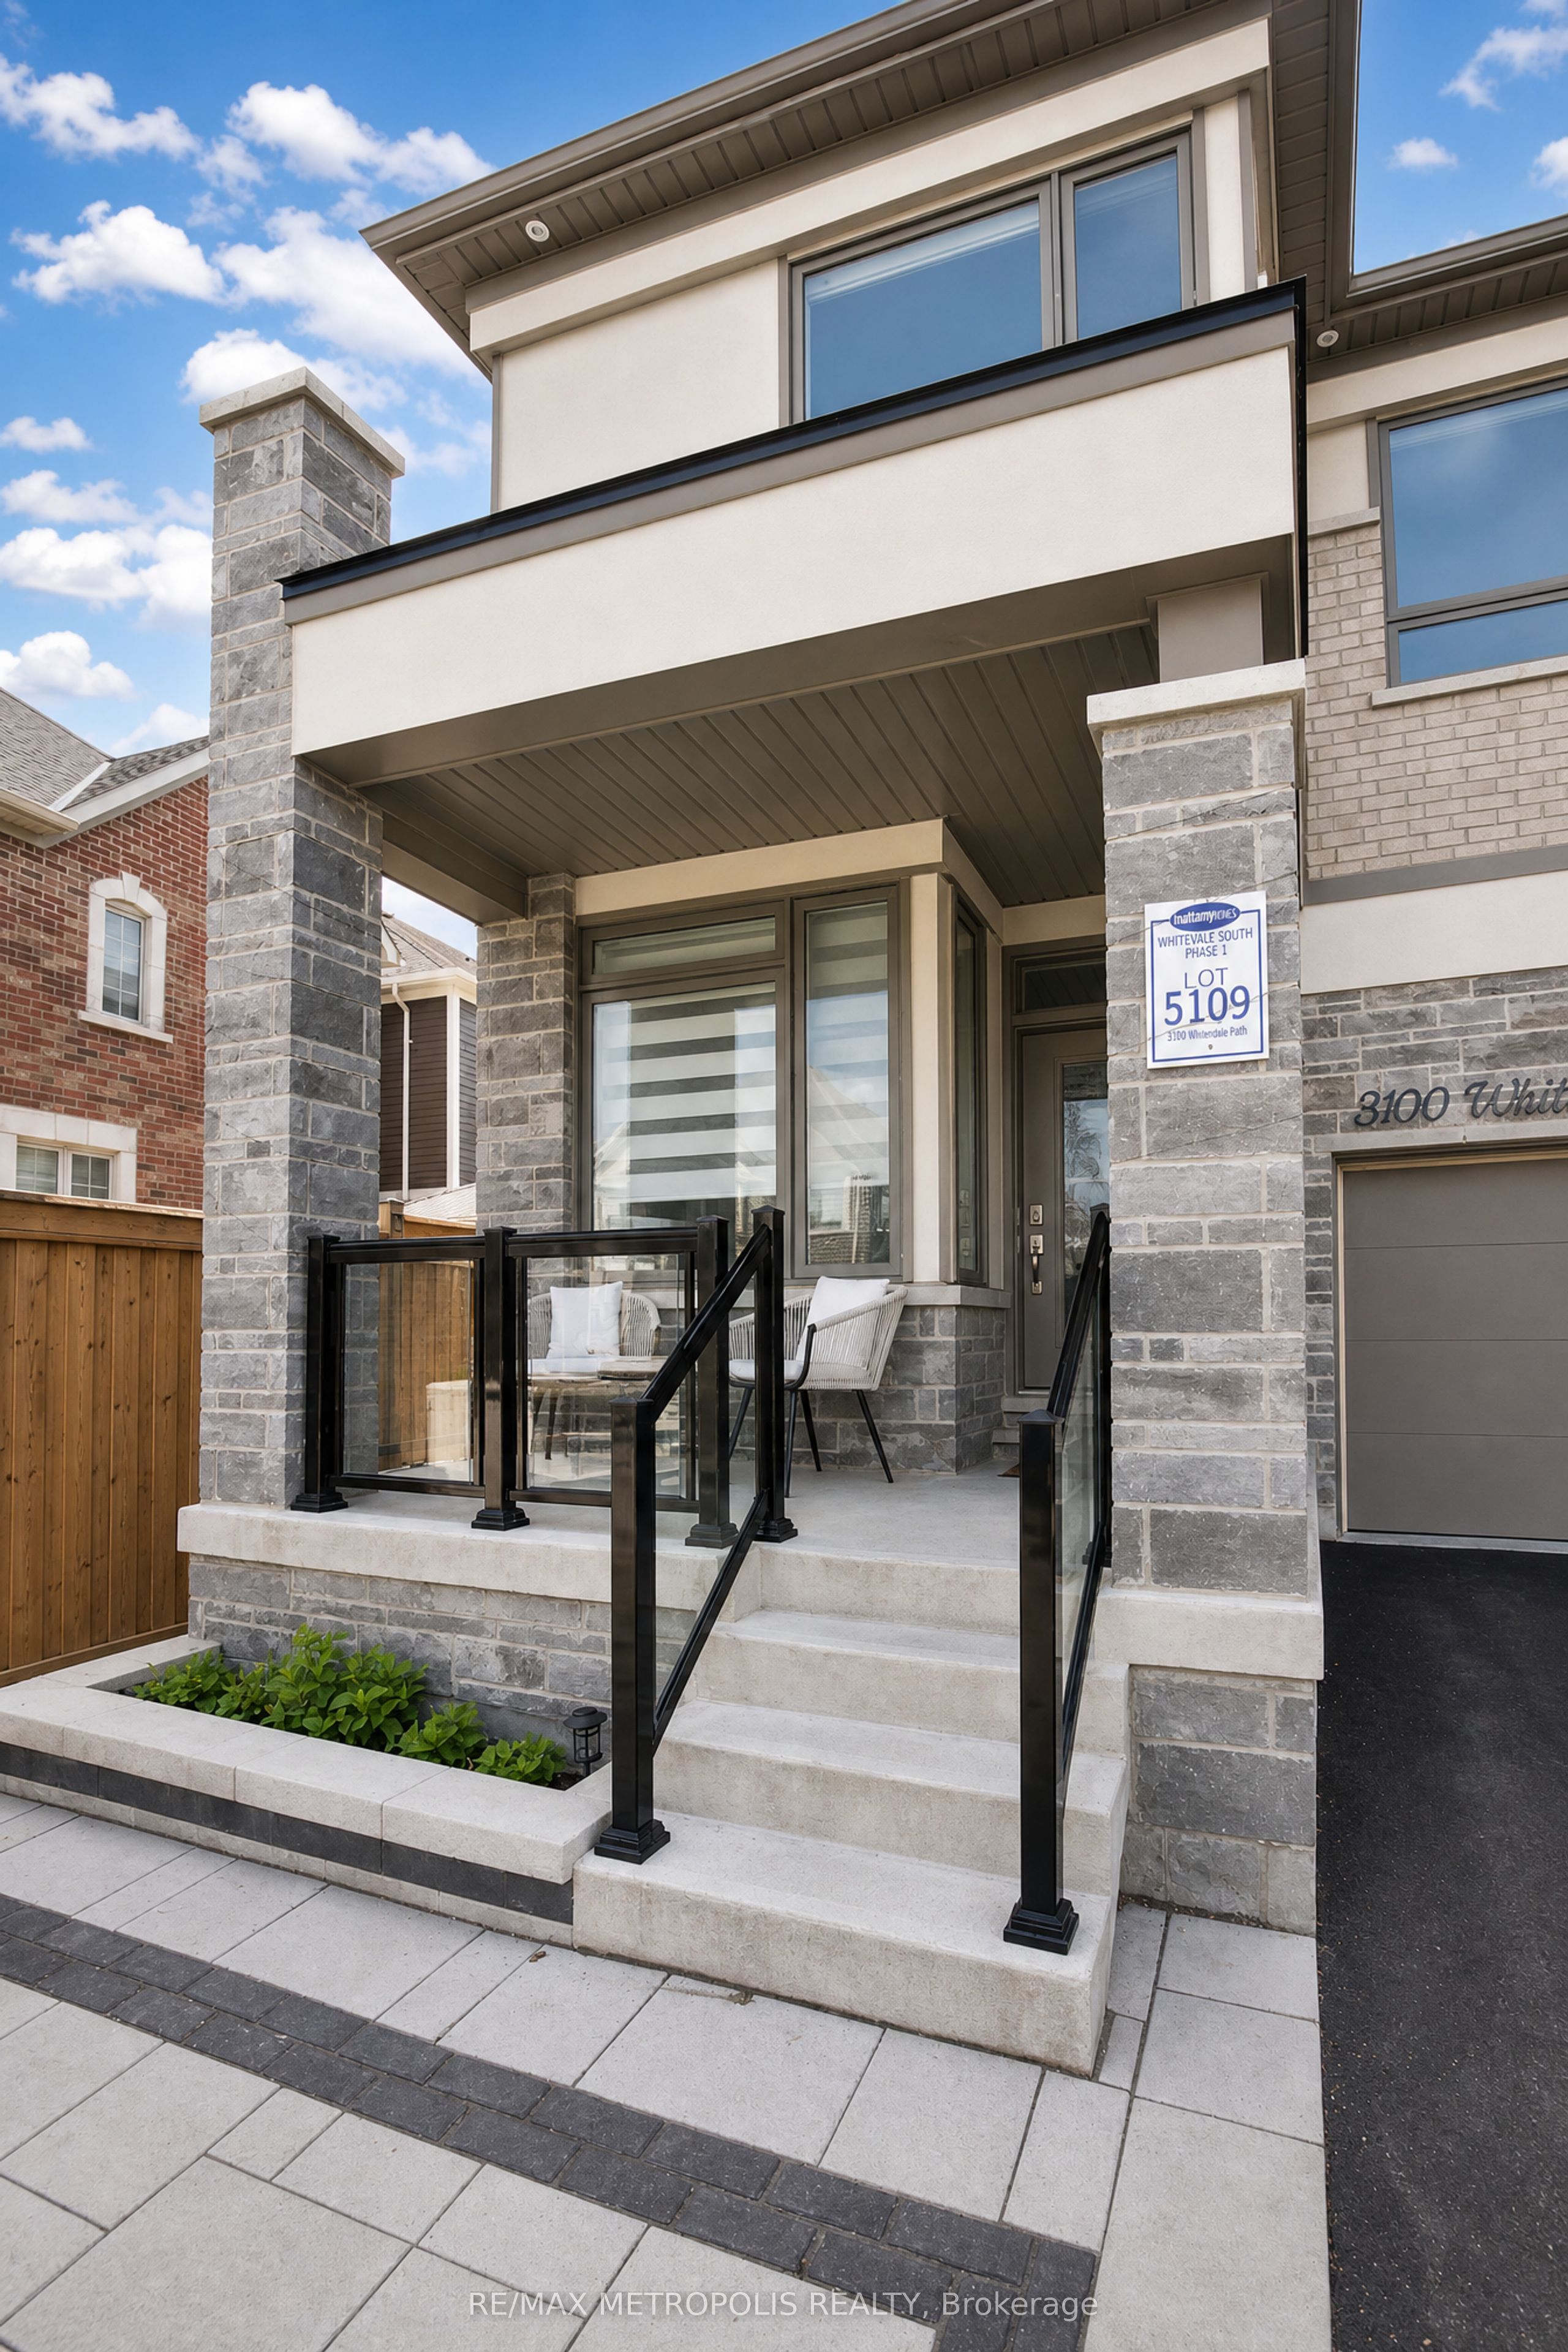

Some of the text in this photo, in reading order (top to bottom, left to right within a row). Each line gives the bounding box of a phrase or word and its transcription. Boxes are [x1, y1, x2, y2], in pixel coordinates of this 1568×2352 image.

[1158, 927, 1253, 948] WHITEVALE SOUTH
[1185, 944, 1227, 959] PHASE 1
[1185, 967, 1228, 989] LOT
[1164, 985, 1250, 1026] 5109
[1167, 1030, 1186, 1041] 3100
[1230, 1025, 1248, 1036] Path
[1354, 1087, 1450, 1126] 3100
